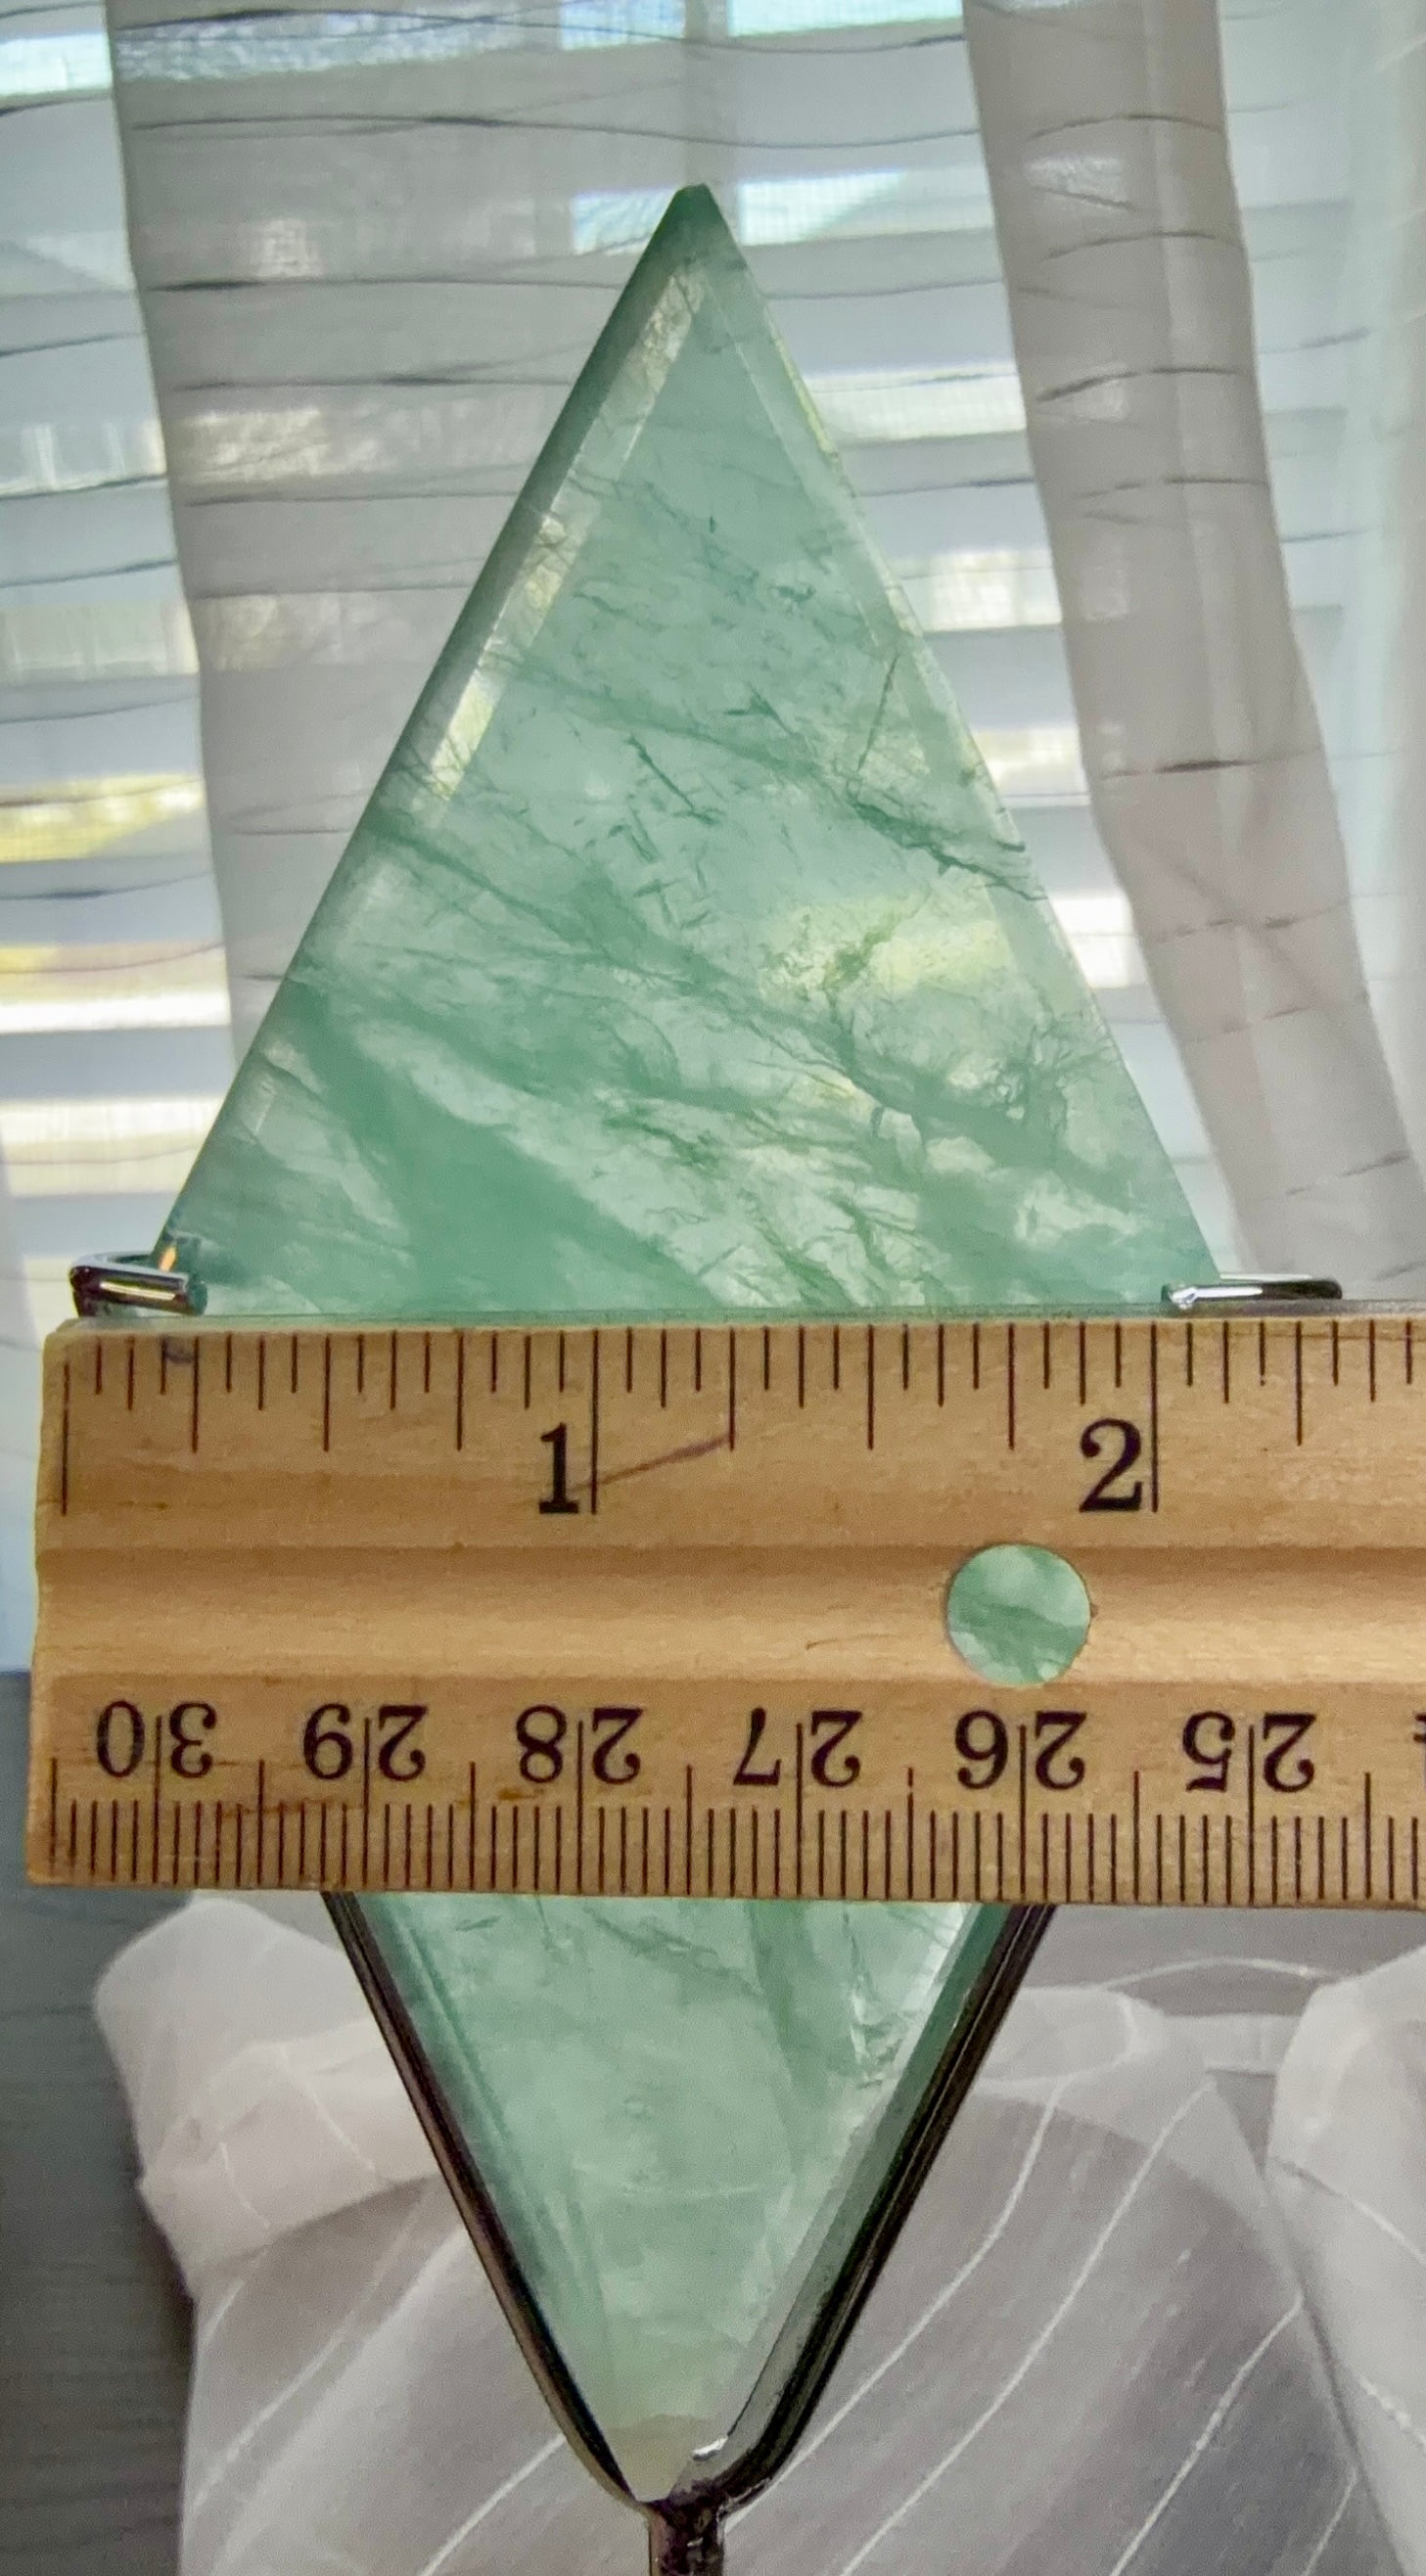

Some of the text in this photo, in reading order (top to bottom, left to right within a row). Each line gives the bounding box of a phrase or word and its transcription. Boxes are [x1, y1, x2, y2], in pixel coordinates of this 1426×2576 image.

[538, 1422, 580, 1515] 1
[1078, 1417, 1144, 1513] 2
[96, 1699, 217, 1778] 30
[302, 1703, 429, 1781] 29
[515, 1704, 645, 1785] 28
[732, 1707, 862, 1788] 27
[954, 1709, 1087, 1790] 26
[1181, 1711, 1316, 1793] 25
